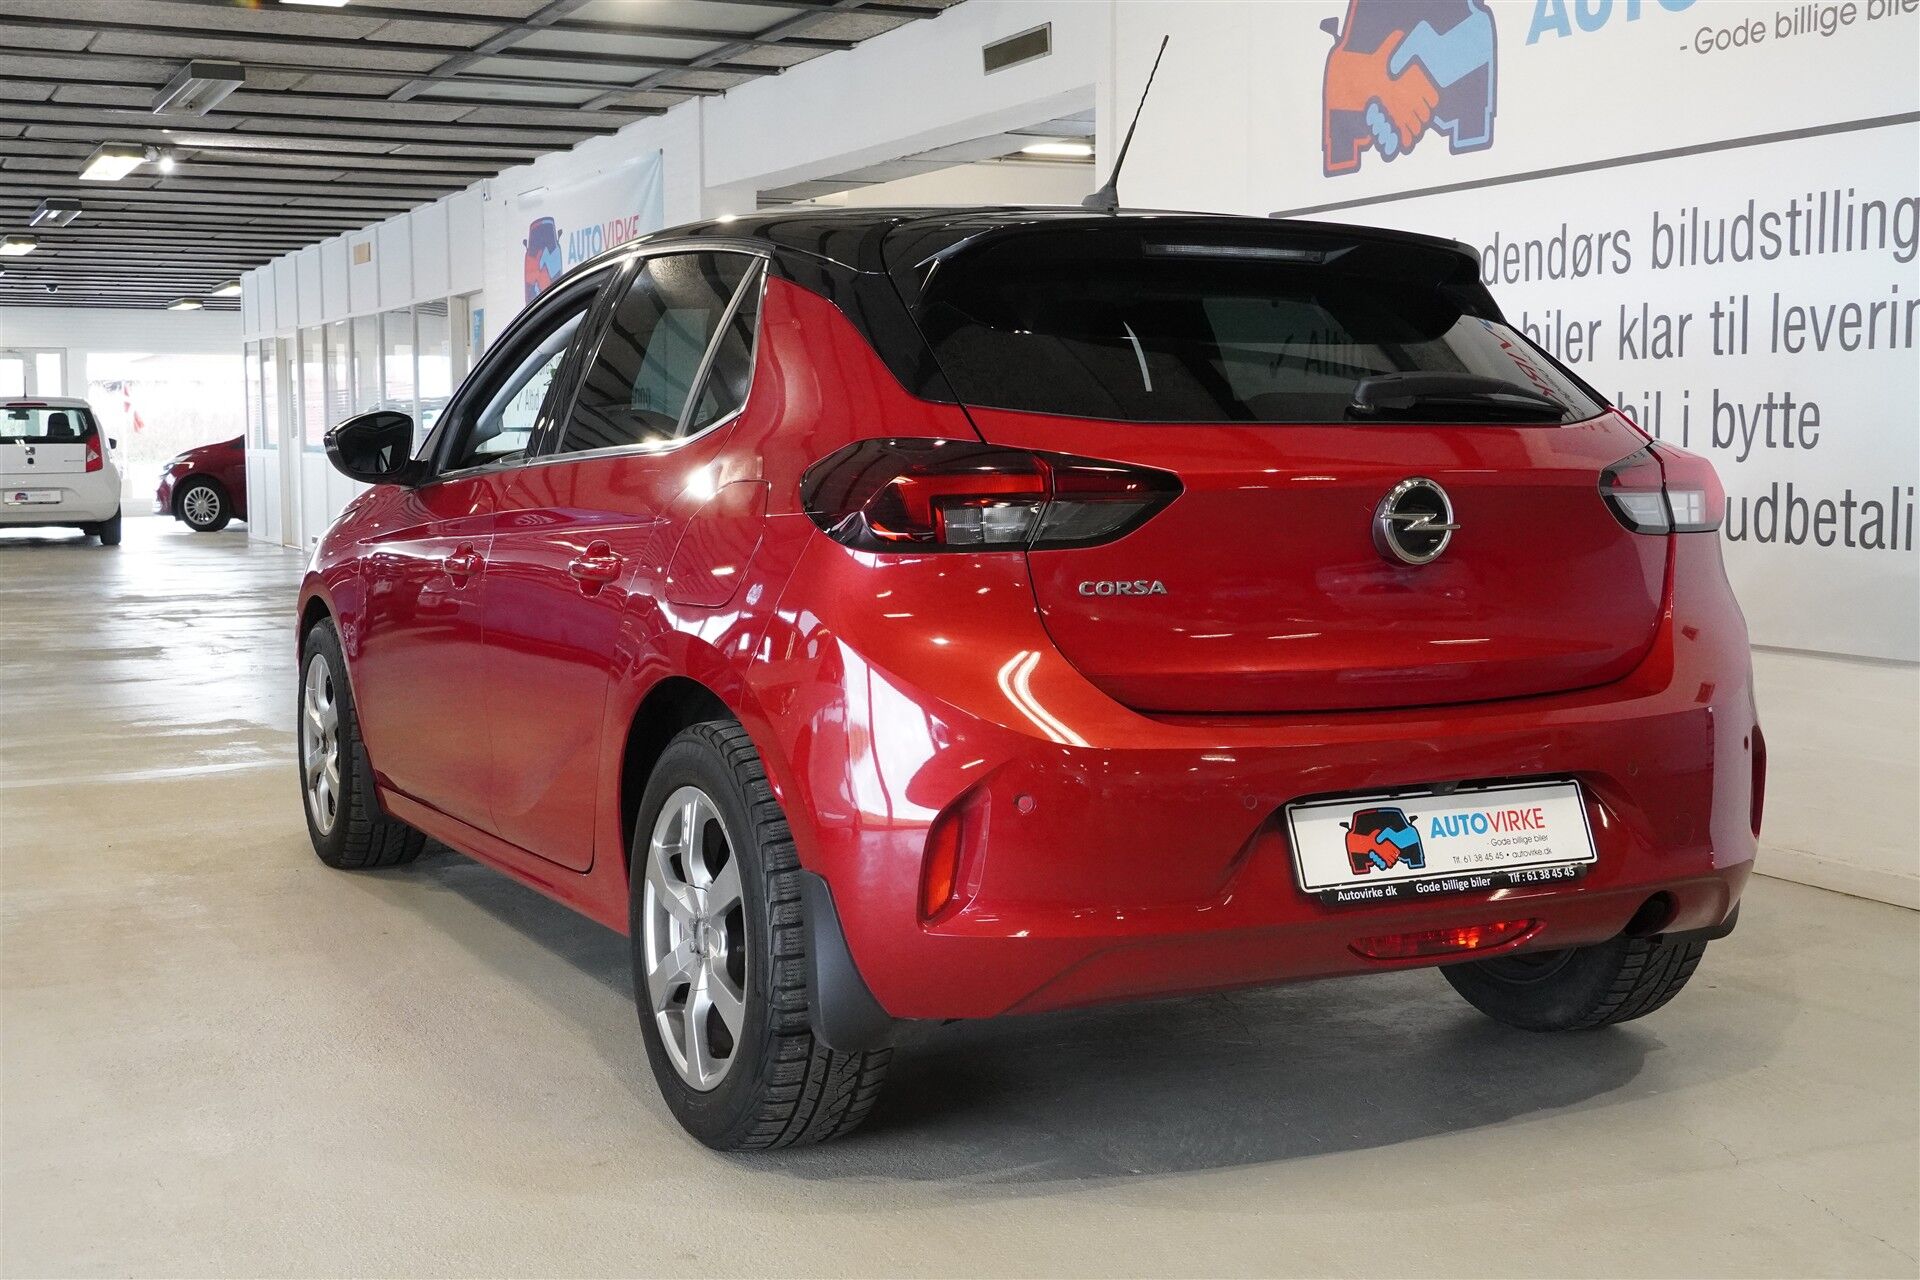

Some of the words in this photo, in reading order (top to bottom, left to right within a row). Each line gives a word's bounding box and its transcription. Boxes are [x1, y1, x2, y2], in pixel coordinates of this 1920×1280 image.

[1694, 18, 1766, 54] Gode
[1775, 2, 1857, 37] billige
[1481, 223, 1632, 287] dendørs
[1651, 187, 1920, 263] biludstilling
[1618, 303, 1693, 361] klar
[1709, 294, 1749, 357] til
[1682, 389, 1690, 448] i
[1711, 388, 1821, 463] bytte
[1078, 580, 1168, 596] CORSA
[1430, 807, 1546, 839] AUTOVIRKE
[1490, 838, 1511, 847] Gode
[1533, 833, 1549, 843] biler
[1463, 854, 1472, 863] 61
[1474, 853, 1484, 862] 38
[1485, 852, 1494, 861] 45
[1495, 851, 1505, 860] 45
[1337, 886, 1383, 902] Autovirke
[1385, 885, 1398, 897] dk
[1415, 881, 1441, 893] Gode
[1441, 878, 1469, 892] billige
[1469, 876, 1491, 888] biler
[1527, 871, 1538, 881] 61
[1540, 869, 1551, 880] 38
[1551, 868, 1563, 879] 45
[1564, 866, 1576, 877] 45
